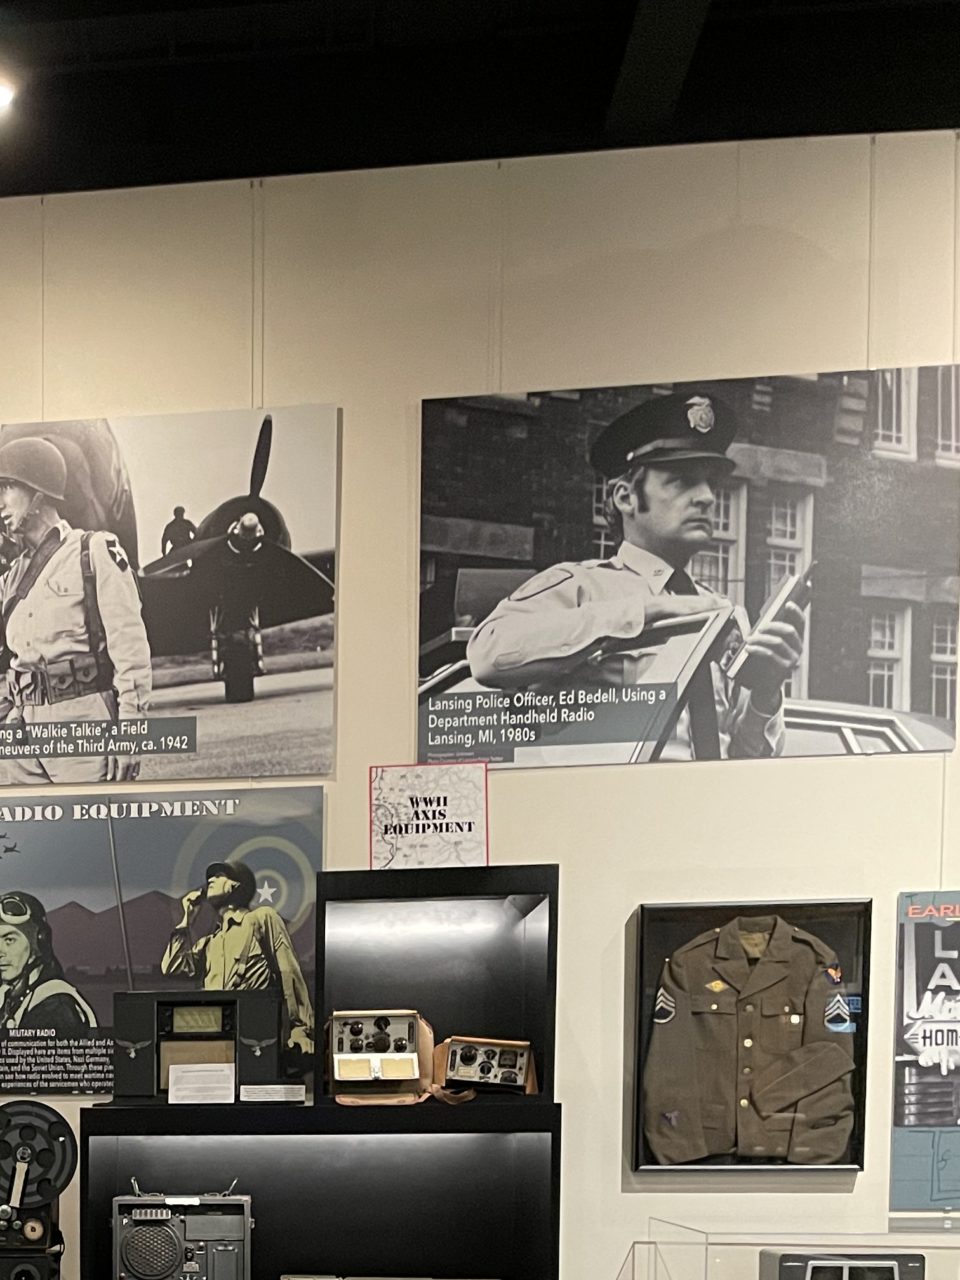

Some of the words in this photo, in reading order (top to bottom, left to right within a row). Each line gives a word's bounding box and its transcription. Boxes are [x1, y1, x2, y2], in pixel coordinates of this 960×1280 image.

[429, 695, 472, 715] Lansing
[477, 694, 509, 709] Police
[514, 692, 557, 709] Officer,
[560, 692, 574, 705] Ed
[579, 690, 618, 707] Bedell,
[623, 688, 655, 706] Using
[659, 691, 665, 701] a
[429, 712, 497, 731] Department
[501, 711, 557, 725] Handheld
[562, 710, 594, 723] Radio
[16, 728, 22, 738] a
[26, 723, 67, 738] “Walkie
[70, 722, 108, 739] Talkie”,
[112, 725, 117, 735] a
[121, 721, 147, 734] Field
[429, 732, 476, 749] Lansing,
[479, 731, 496, 746] MI,
[501, 729, 535, 743] 1980s
[43, 741, 53, 753] of
[56, 740, 75, 753] the
[77, 739, 104, 752] Third
[108, 738, 139, 755] Army,
[142, 740, 158, 750] ca.
[161, 737, 188, 749] 1942
[74, 800, 239, 819] EQUIPMENT
[409, 796, 448, 808] WWII
[412, 809, 447, 820] AXIS
[384, 822, 475, 835] EQUIPMENT
[9, 1029, 36, 1037] MILITARY
[36, 1028, 56, 1037] RADIO
